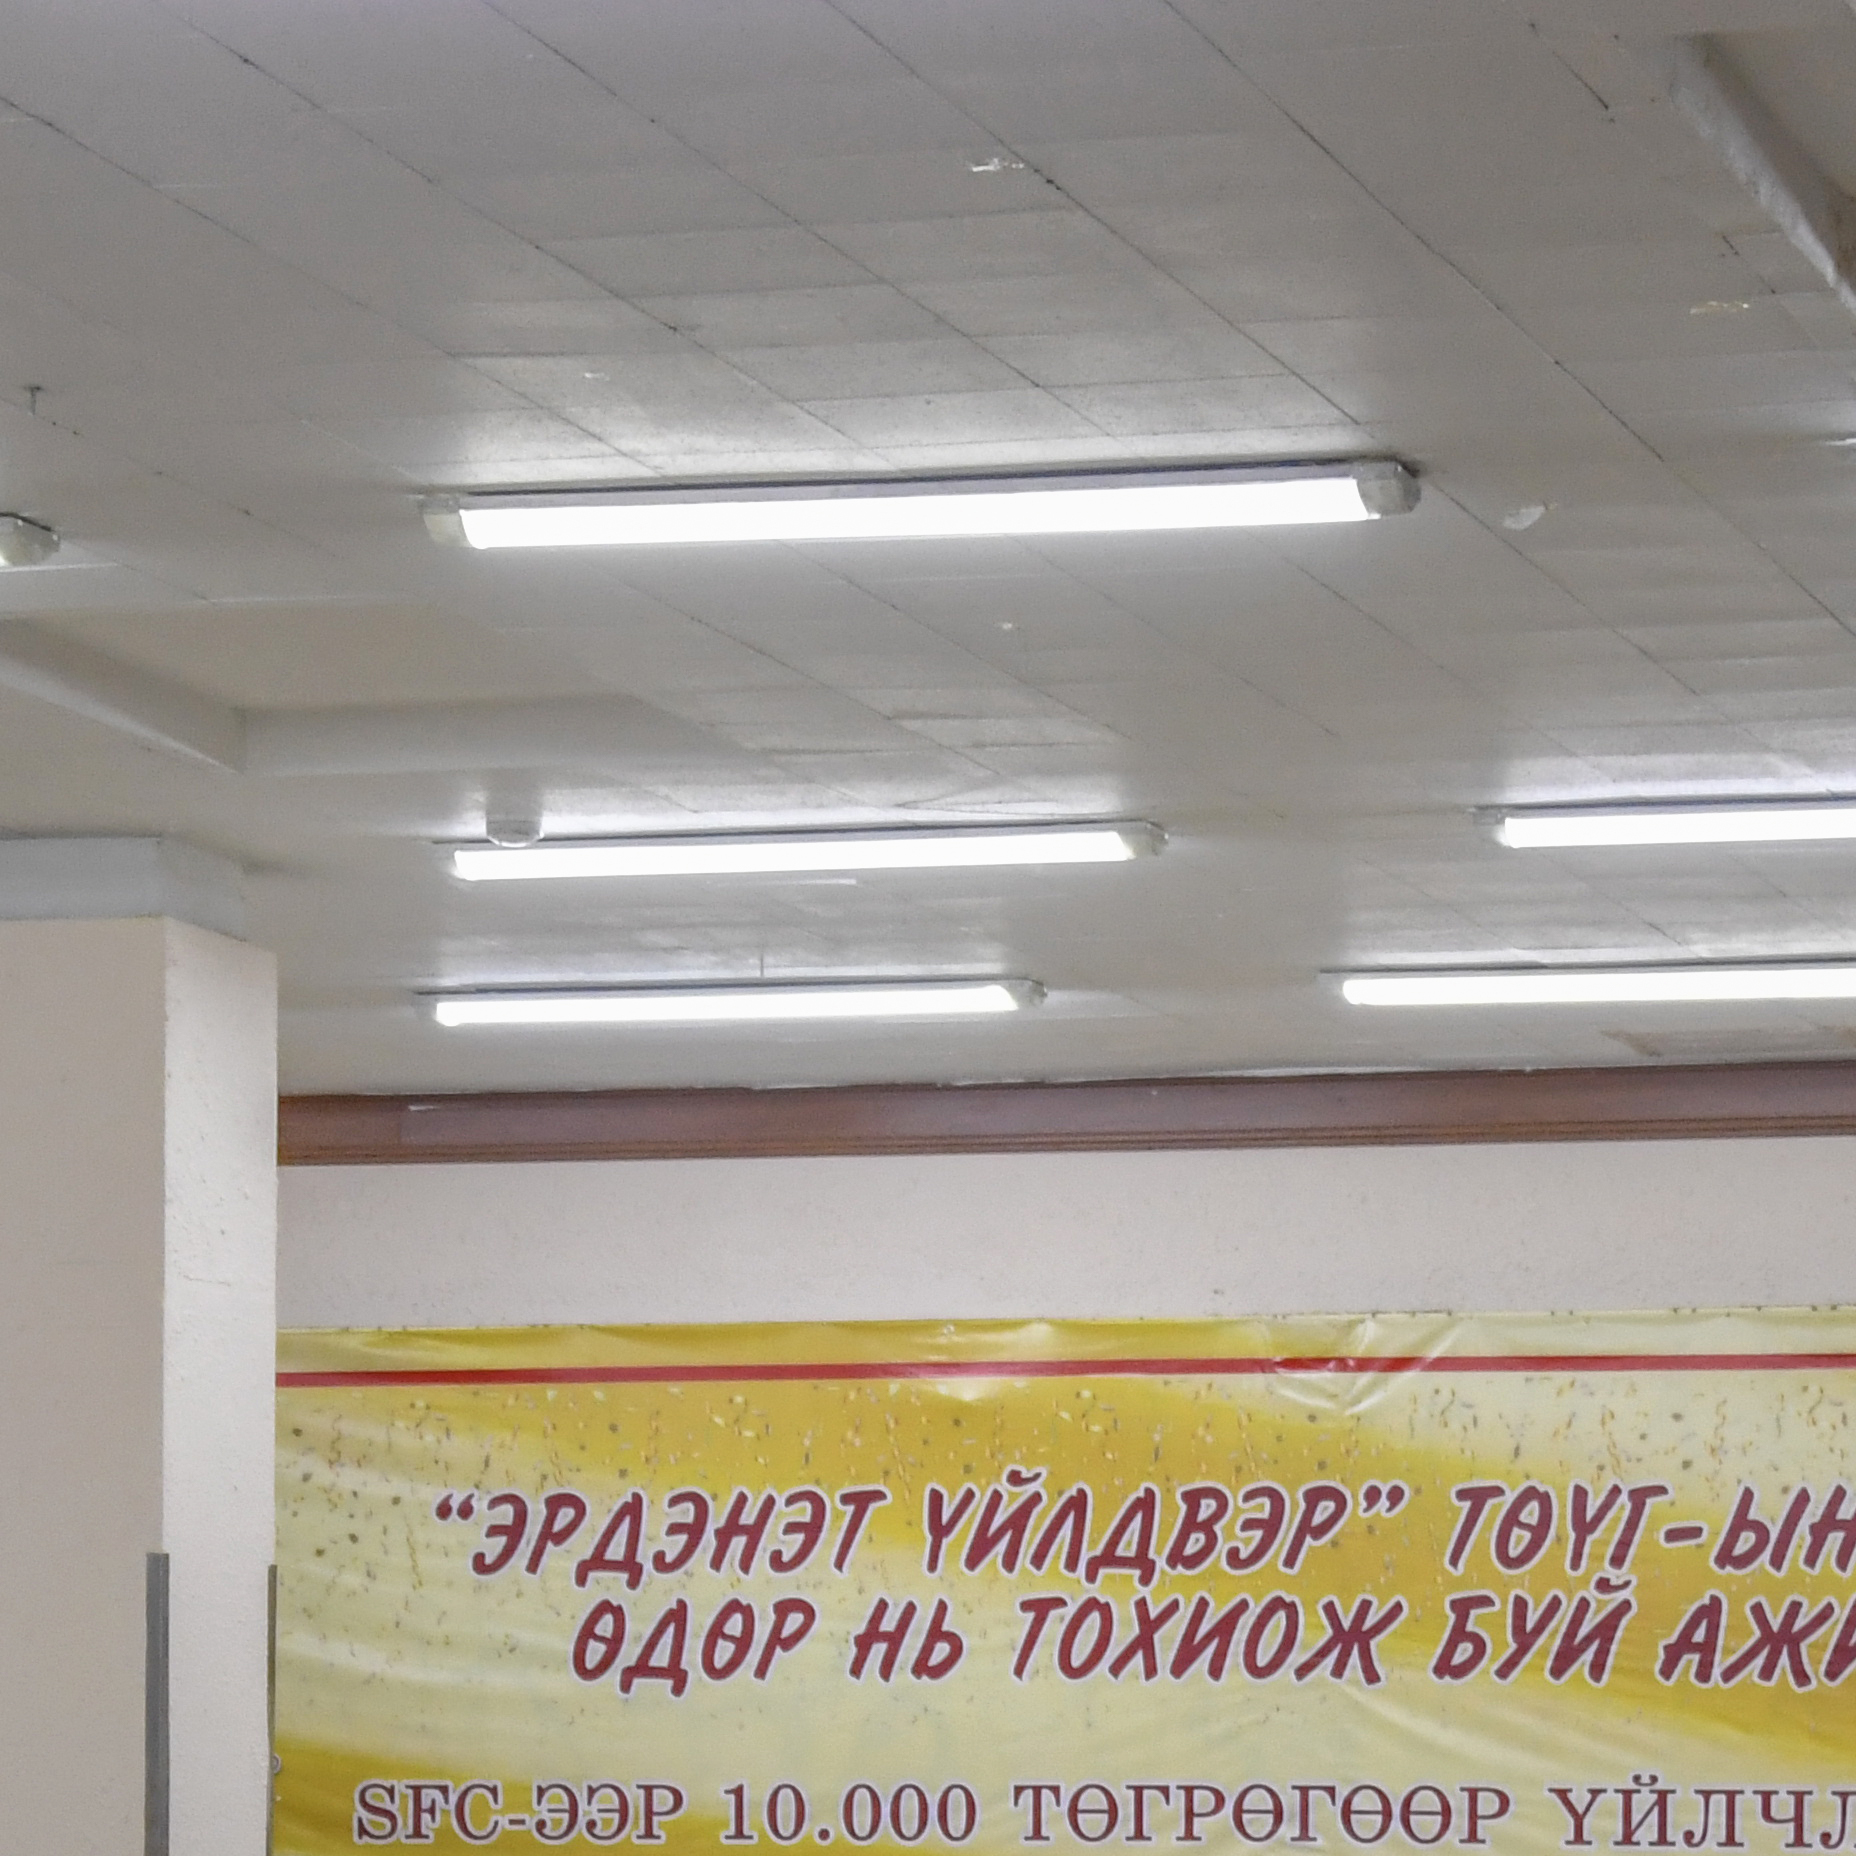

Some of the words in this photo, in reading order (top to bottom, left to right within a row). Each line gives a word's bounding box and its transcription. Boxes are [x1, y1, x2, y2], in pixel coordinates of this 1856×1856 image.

[574, 1597, 816, 1696] ӨДӨР
[851, 1600, 964, 1680] НЬ
[1015, 1596, 1403, 1684] ТОХИОЖ
[1434, 1576, 1631, 1680] БУЙ
[356, 1782, 685, 1842] SFC-ЭЭР
[724, 1782, 978, 1843] 10.000
[1012, 1782, 1512, 1845] ТӨГРӨГӨӨР
